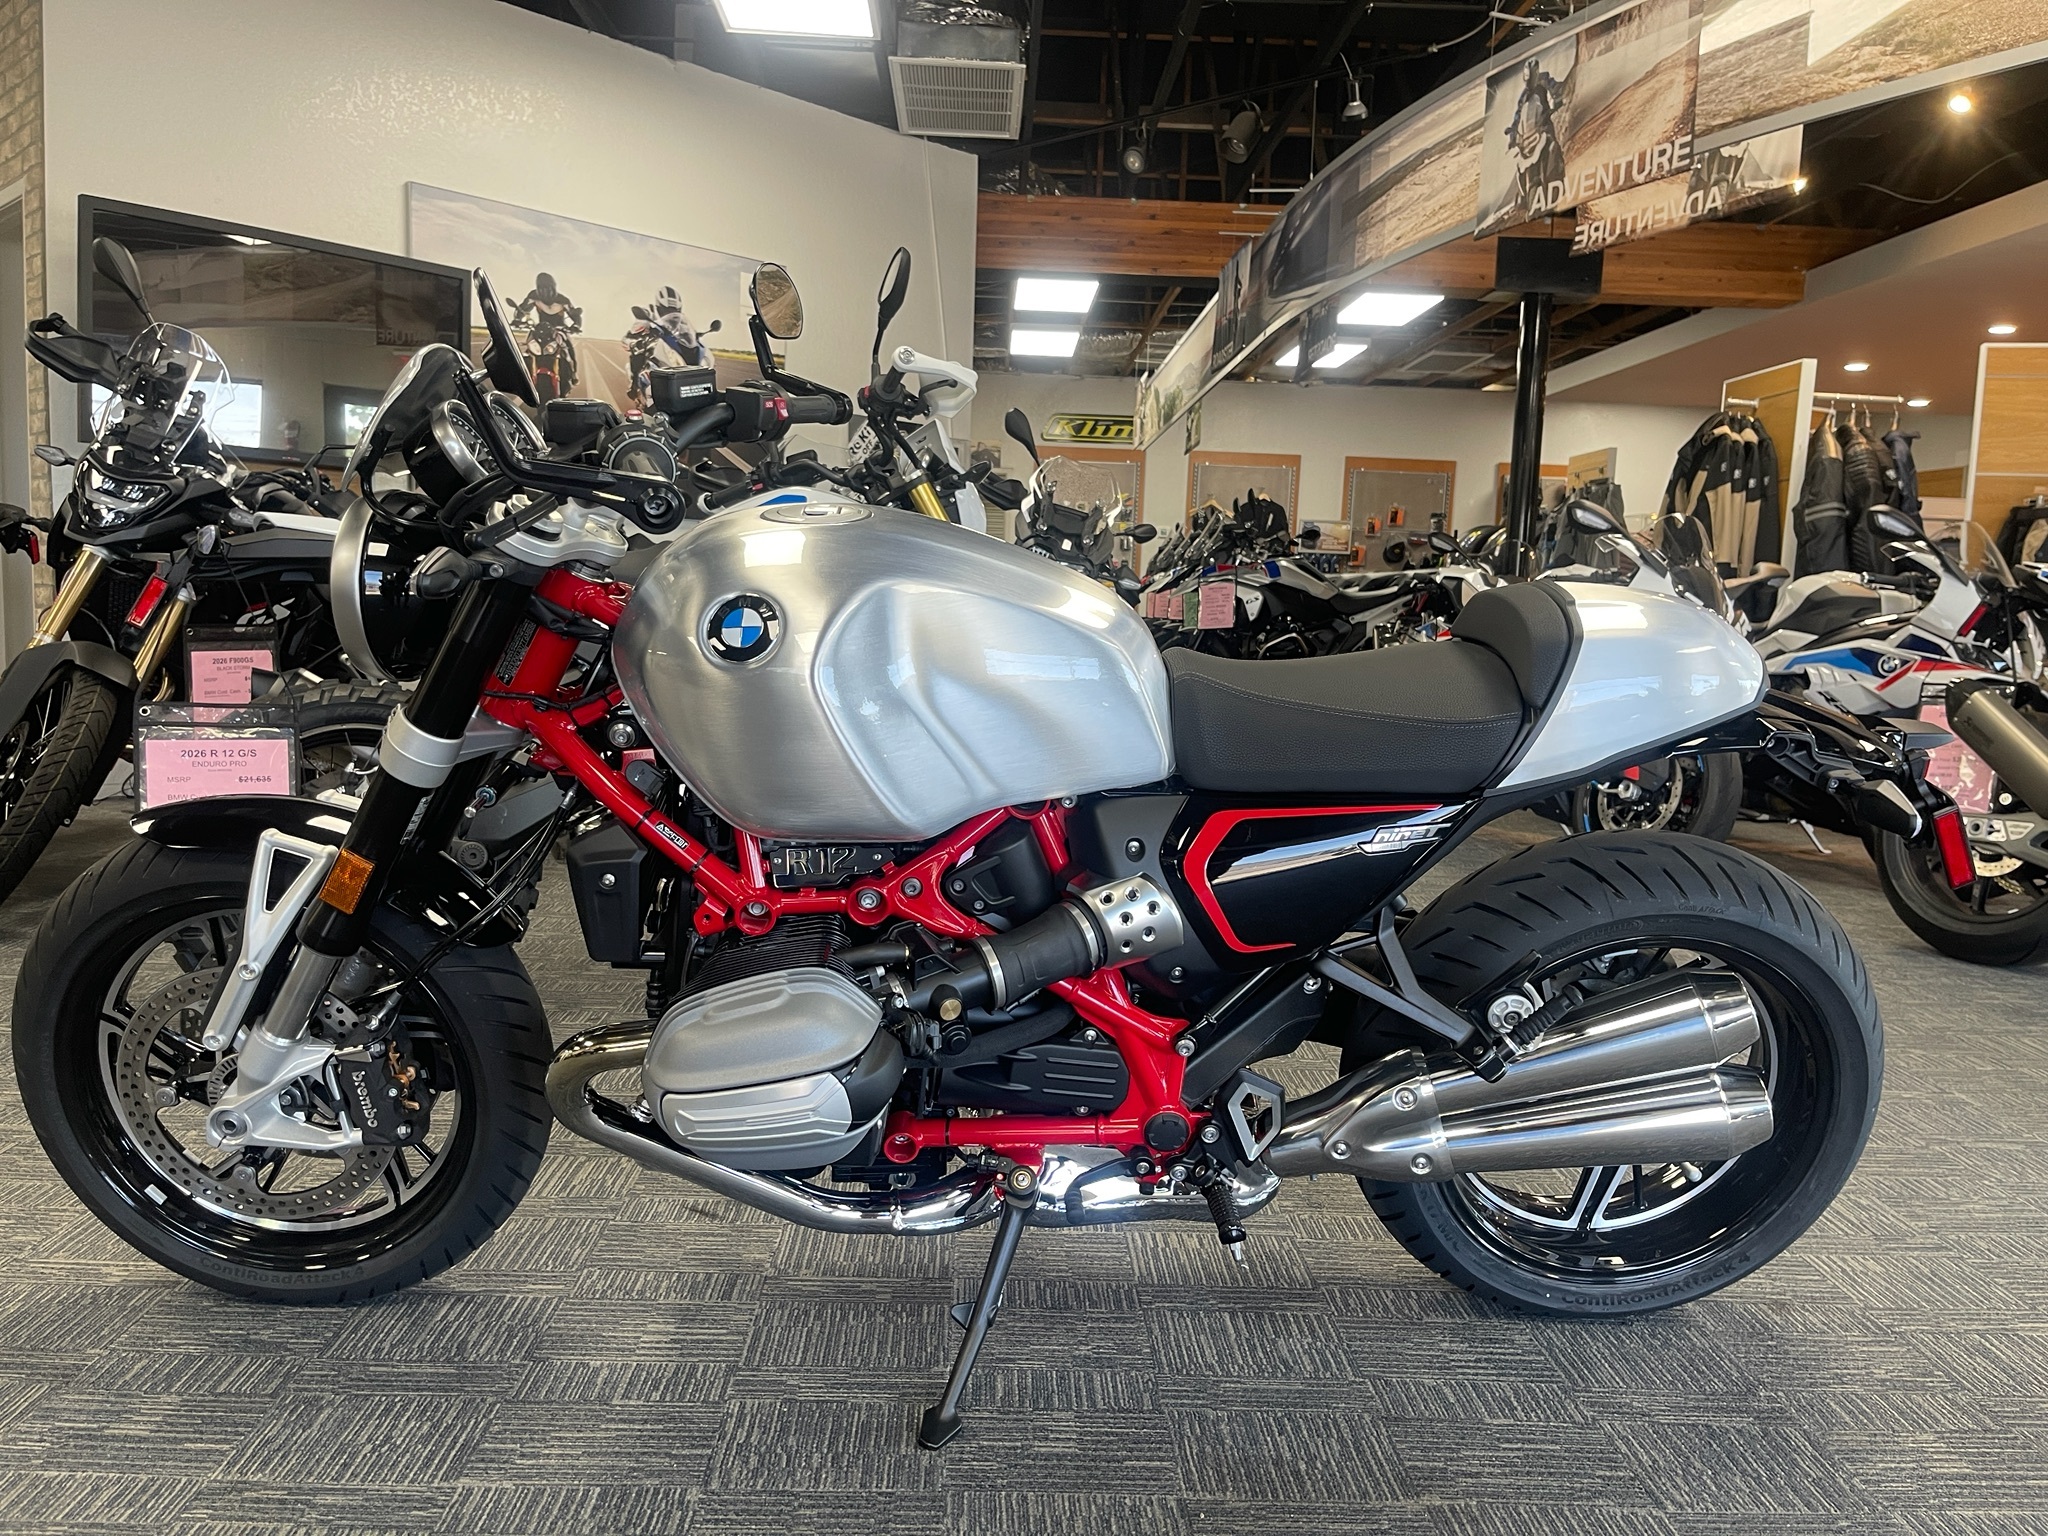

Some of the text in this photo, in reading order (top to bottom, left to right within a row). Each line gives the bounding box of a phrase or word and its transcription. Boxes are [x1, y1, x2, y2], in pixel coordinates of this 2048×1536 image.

[1528, 134, 1692, 216] ADVENTURE
[180, 748, 257, 758] 2026 R 12 G/S
[191, 760, 247, 768] ENDURO PRO
[351, 1070, 378, 1128] brembo
